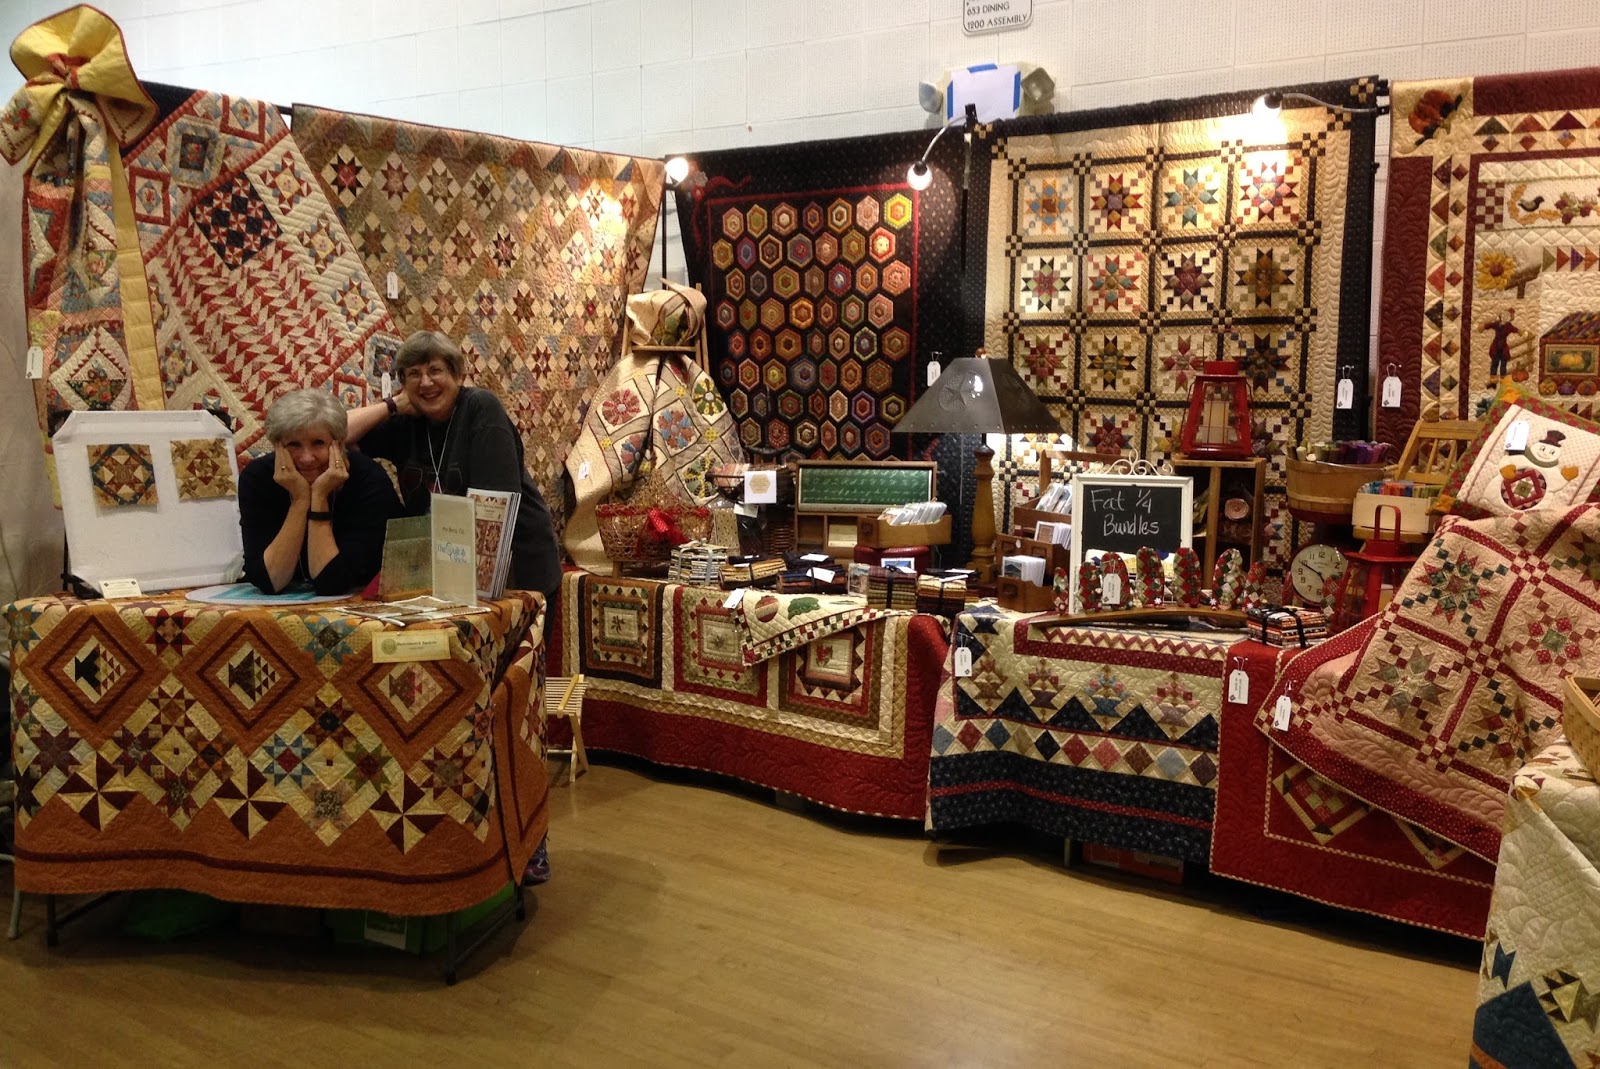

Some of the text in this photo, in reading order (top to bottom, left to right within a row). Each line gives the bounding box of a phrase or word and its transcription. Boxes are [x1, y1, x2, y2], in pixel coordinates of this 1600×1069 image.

[967, 2, 1009, 16] 653 DINING
[967, 14, 1027, 29] 1200 ASSEMBLY
[1090, 489, 1125, 512] Fat
[1103, 513, 1160, 536] Bundles
